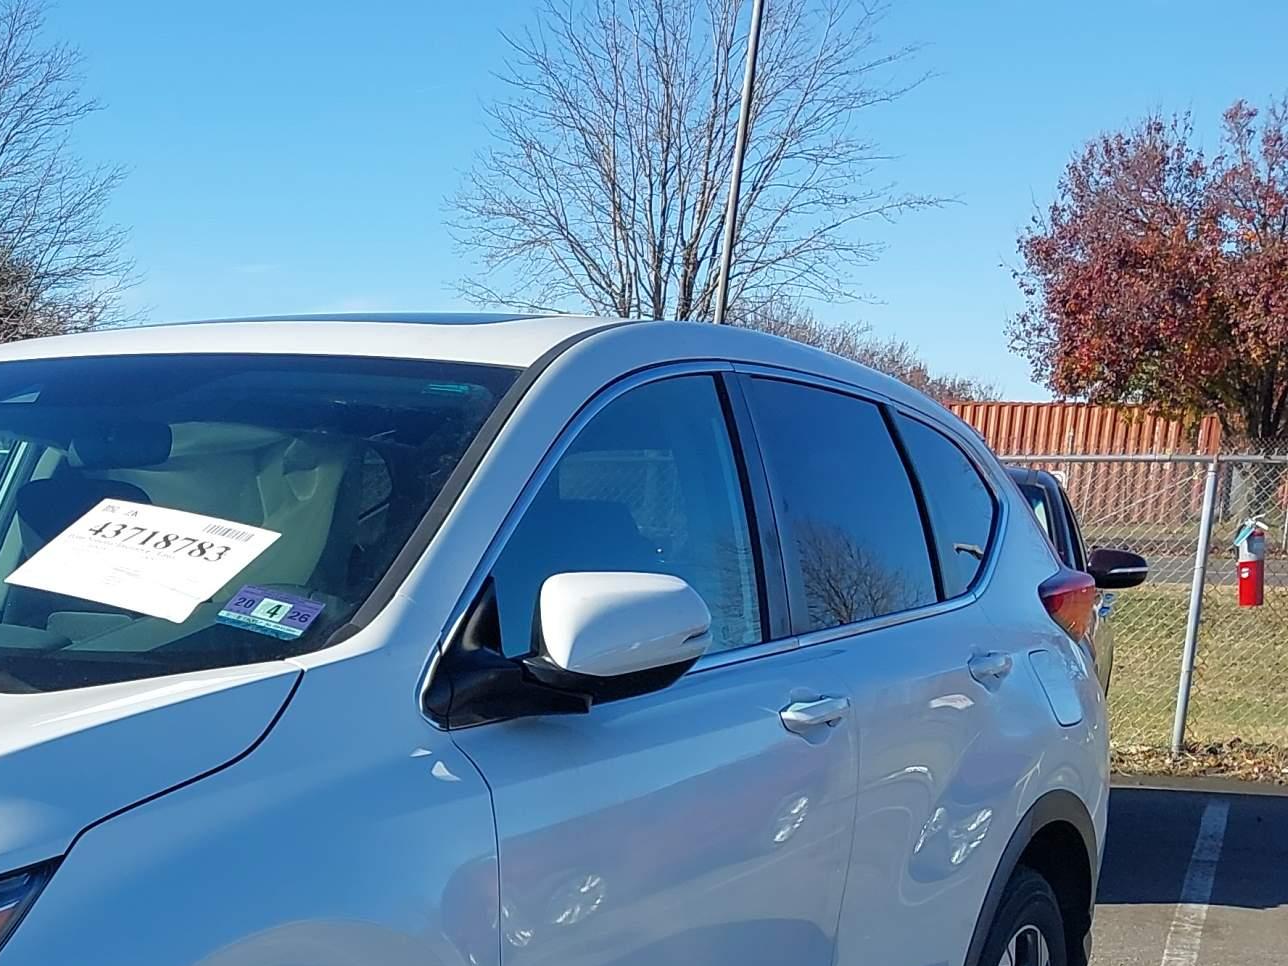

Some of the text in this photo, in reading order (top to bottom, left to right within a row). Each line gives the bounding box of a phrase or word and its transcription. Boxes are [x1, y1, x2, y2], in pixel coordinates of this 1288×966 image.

[88, 521, 232, 562] 43718783
[234, 597, 312, 623] 20 4 26
